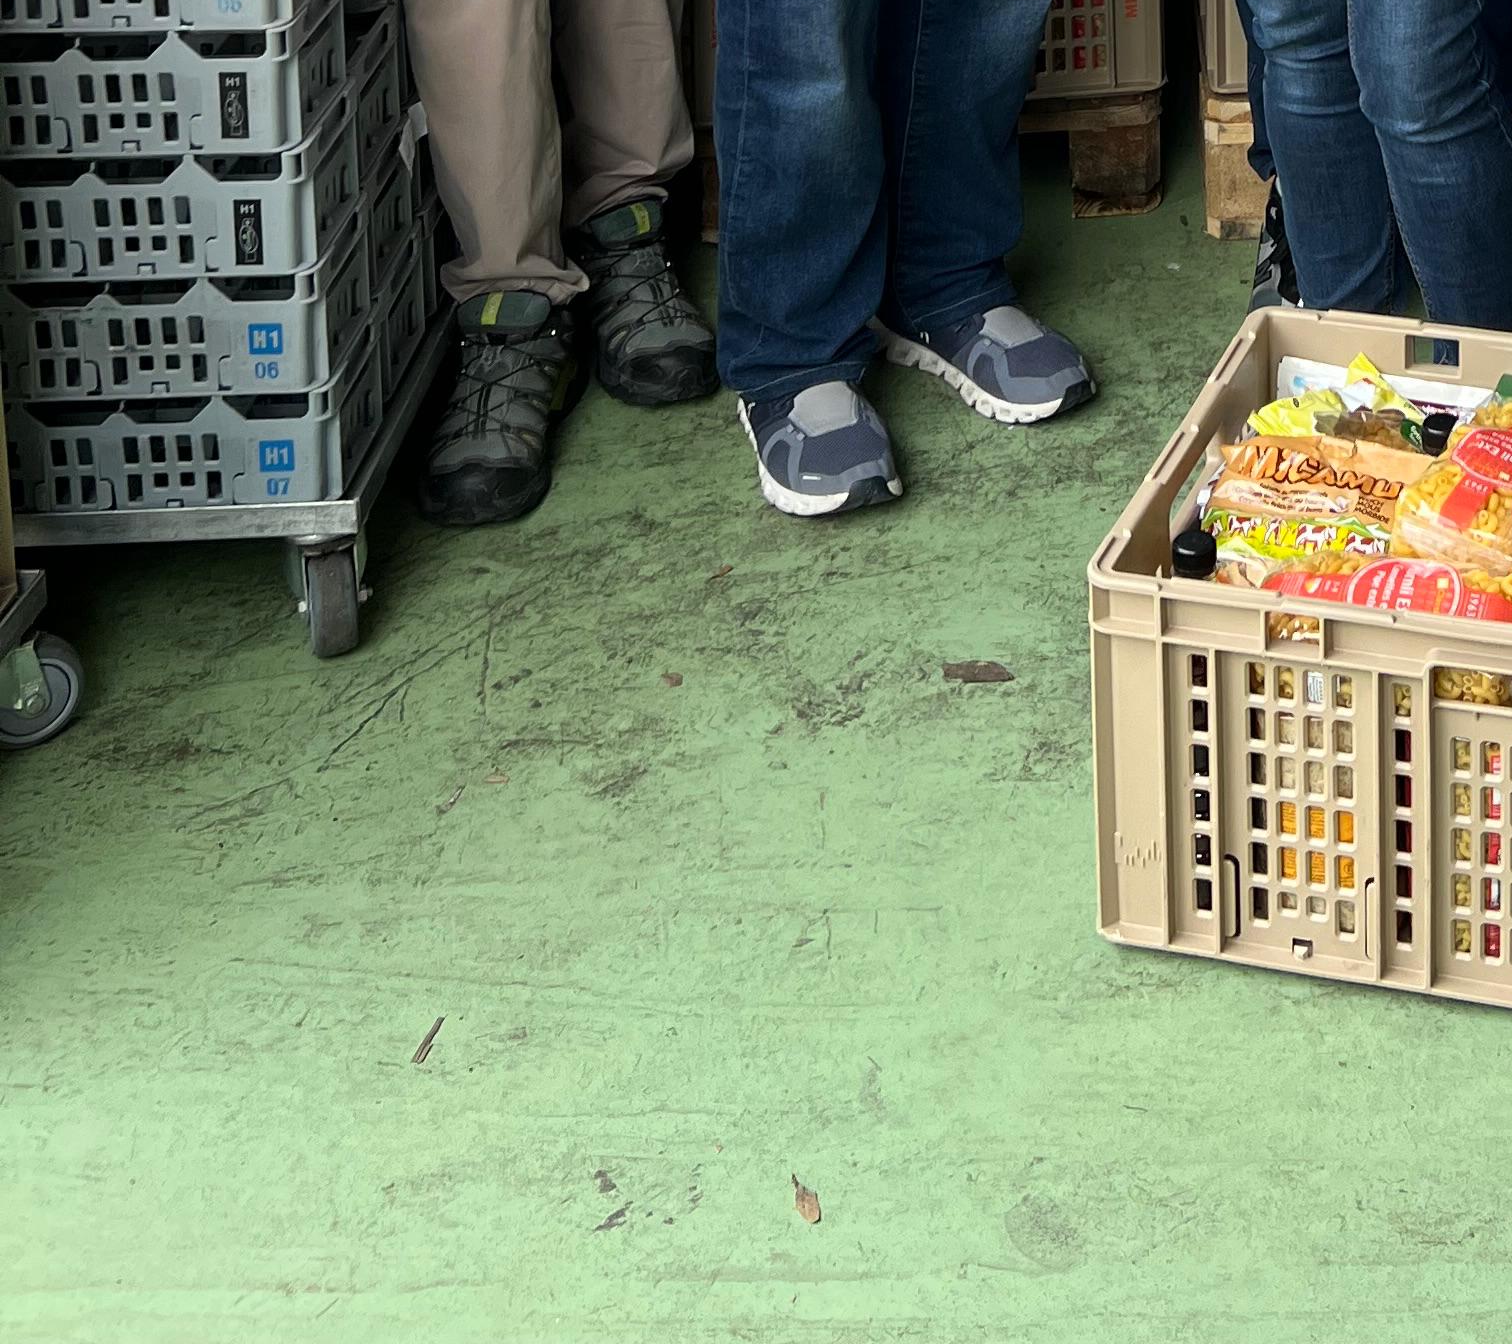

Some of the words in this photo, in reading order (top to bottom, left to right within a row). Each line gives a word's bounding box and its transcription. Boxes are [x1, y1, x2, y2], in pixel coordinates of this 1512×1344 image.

[225, 76, 240, 87] H1
[240, 204, 255, 214] H1
[253, 330, 279, 349] H1
[255, 362, 280, 379] 06
[265, 447, 288, 465] H1
[267, 478, 290, 497] 07
